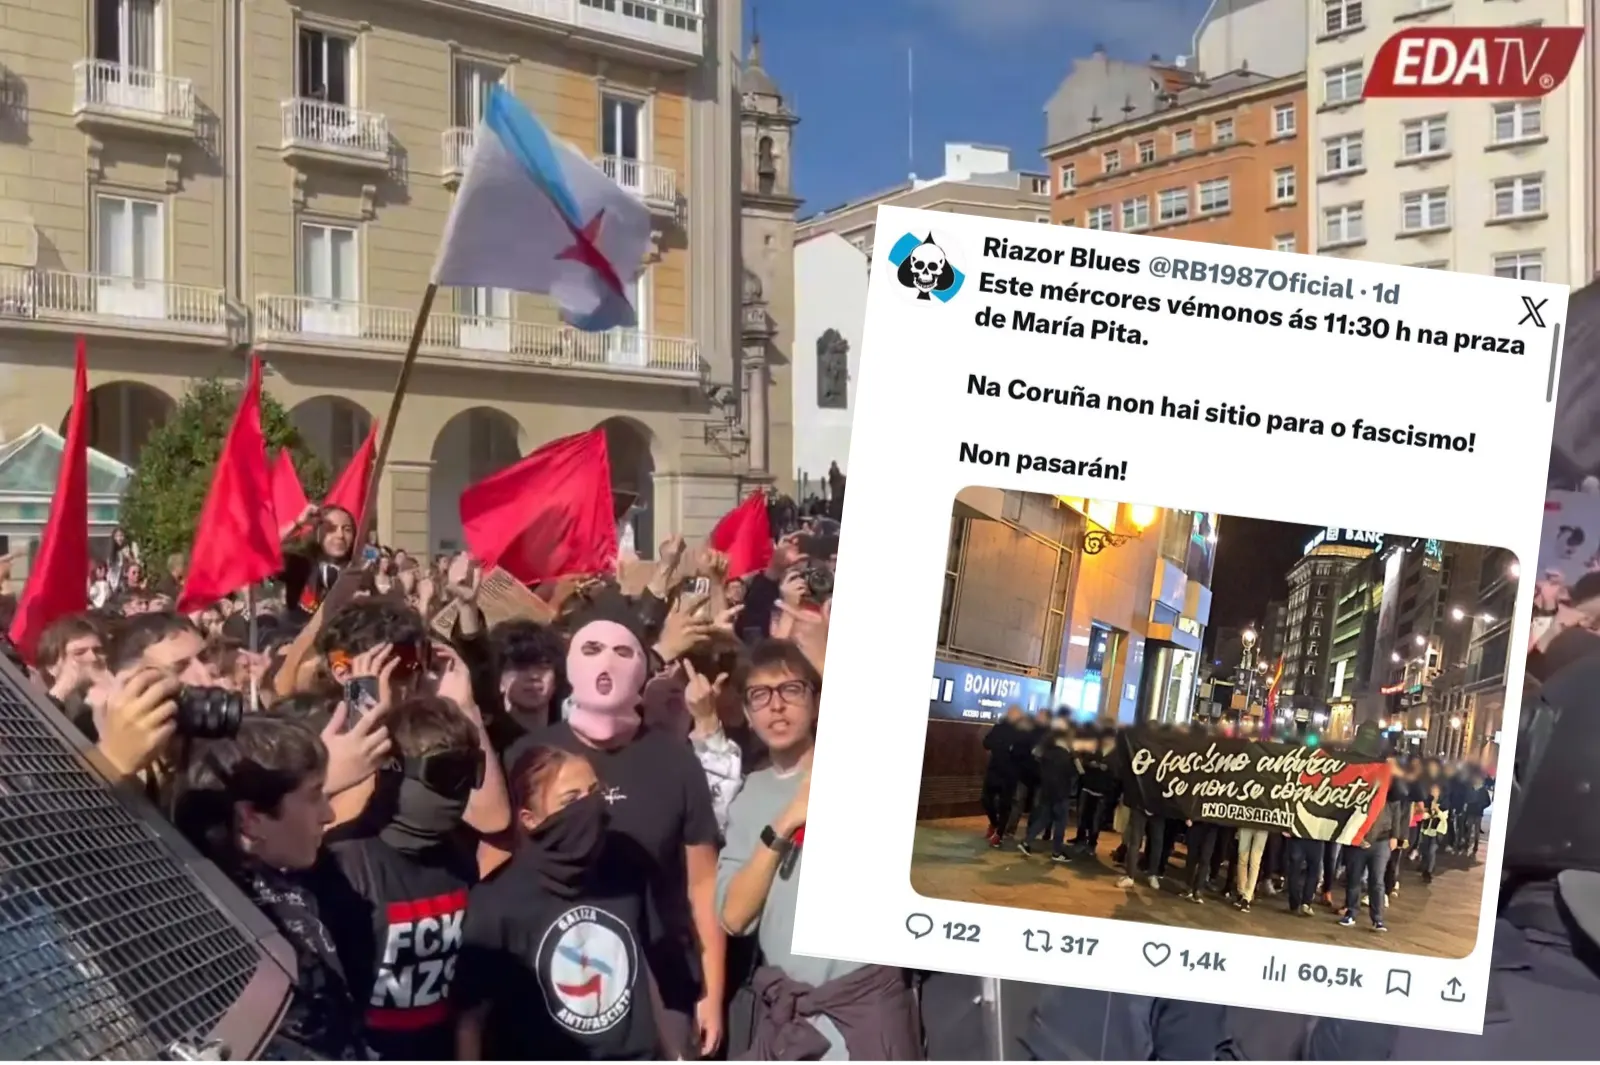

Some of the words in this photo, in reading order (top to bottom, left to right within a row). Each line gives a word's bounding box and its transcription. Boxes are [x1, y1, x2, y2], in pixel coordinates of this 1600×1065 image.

[964, 672, 1021, 698] BOAVISTA
[1131, 748, 1154, 775] O
[1162, 776, 1189, 798] se
[1191, 778, 1238, 799] non
[1236, 778, 1265, 801] se
[382, 909, 465, 964] FCK
